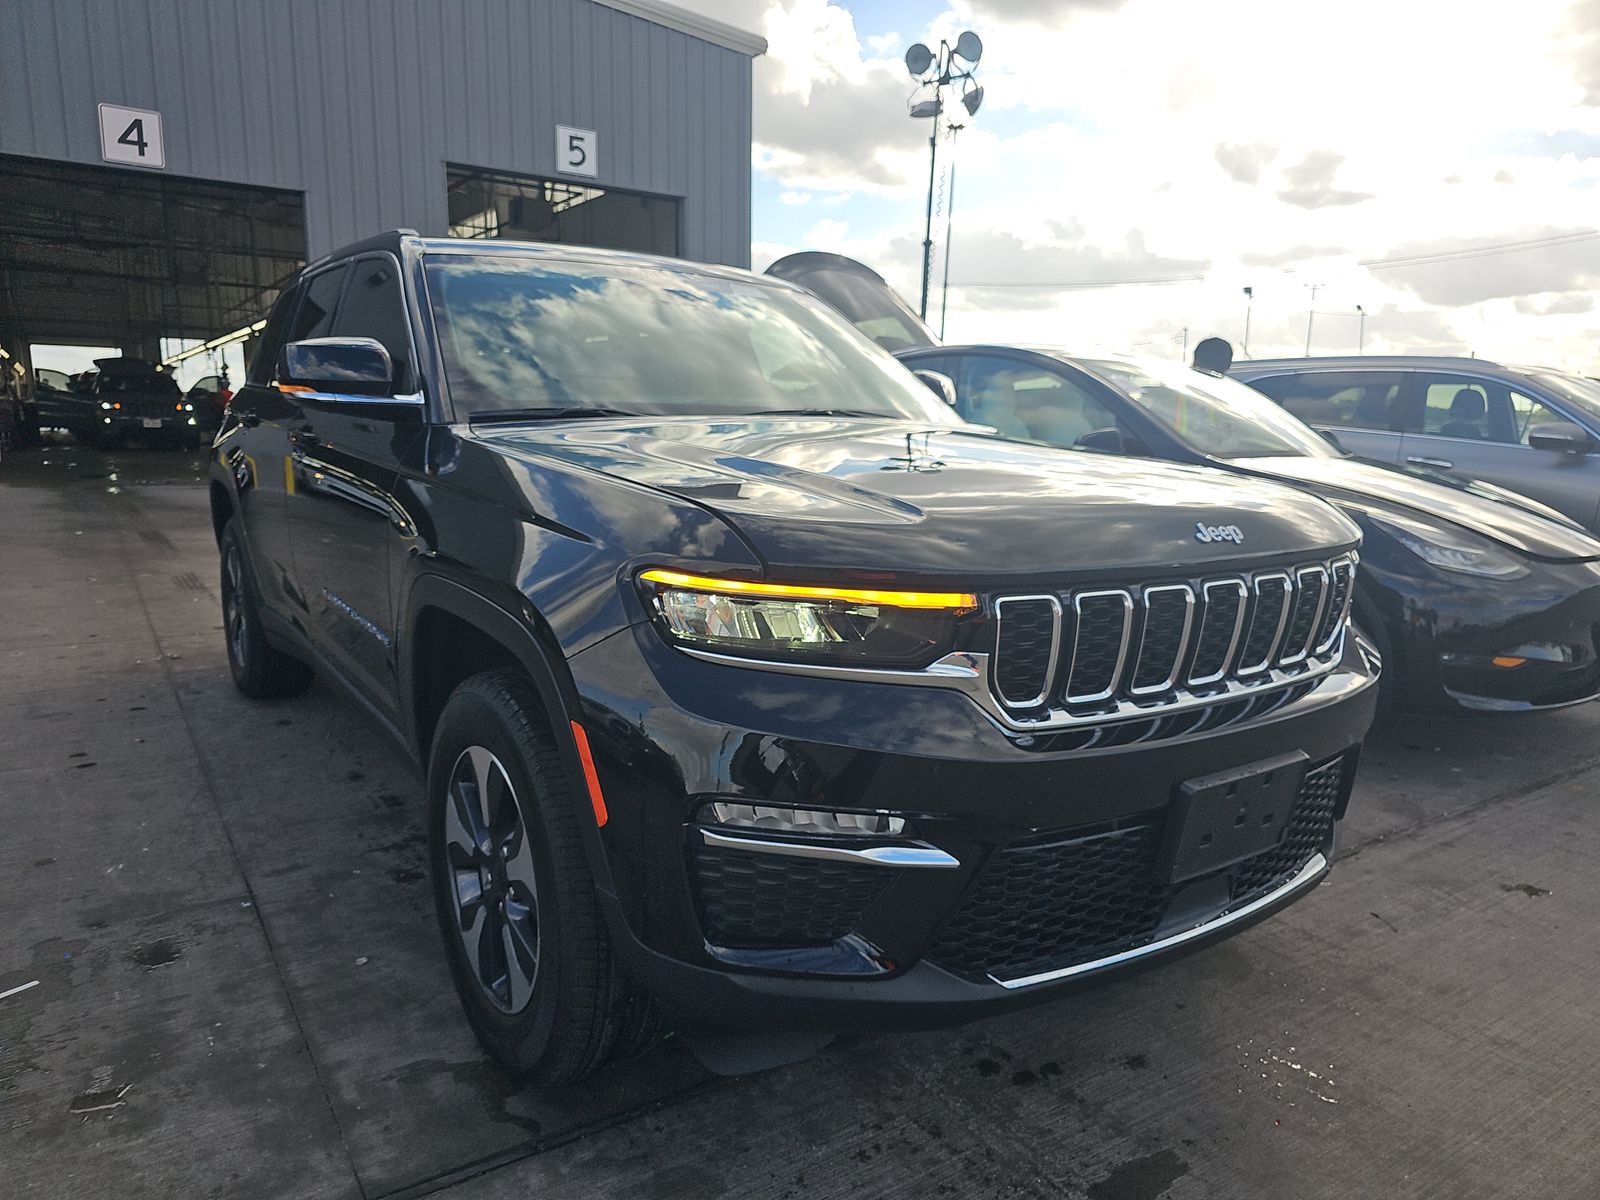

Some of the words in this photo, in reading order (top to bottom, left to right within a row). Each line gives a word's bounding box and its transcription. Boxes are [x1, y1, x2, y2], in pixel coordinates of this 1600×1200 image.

[118, 118, 148, 156] 4
[569, 135, 586, 166] 5
[1195, 521, 1244, 545] Jeep
